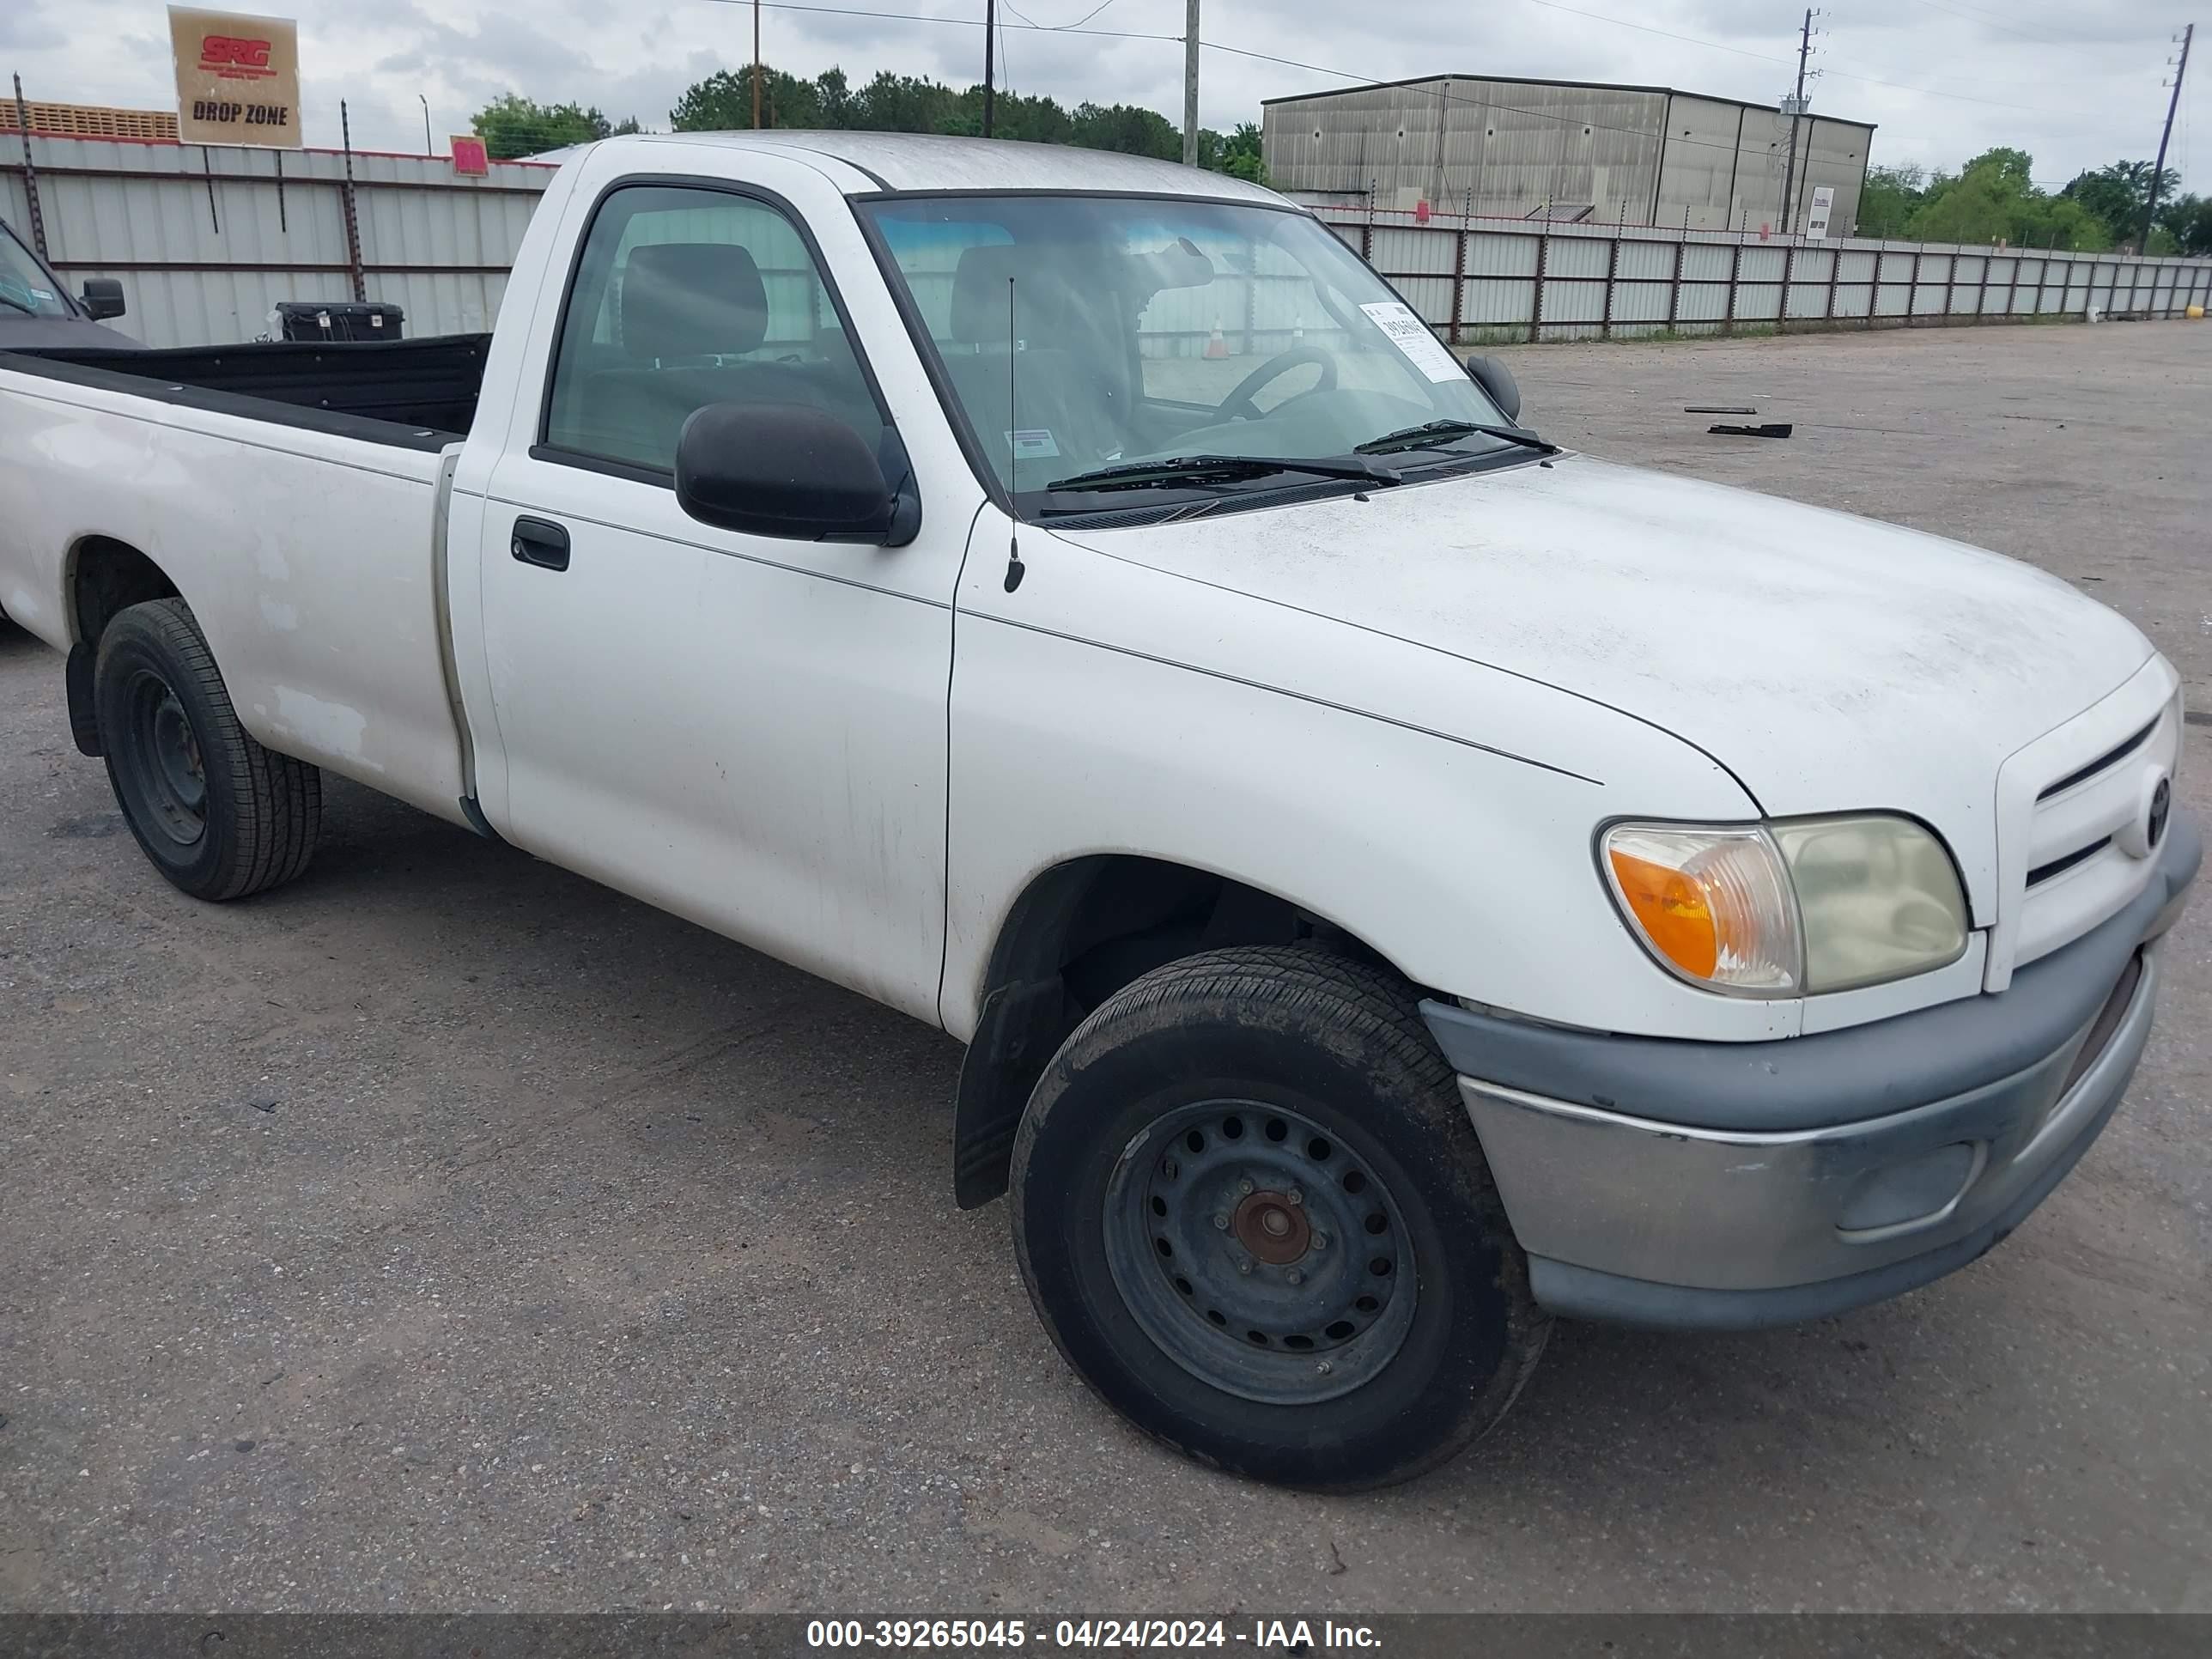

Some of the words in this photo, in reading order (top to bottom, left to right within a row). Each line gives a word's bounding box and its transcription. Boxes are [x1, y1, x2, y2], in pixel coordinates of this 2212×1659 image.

[201, 35, 271, 66] SRG
[192, 100, 242, 122] DROP
[246, 104, 289, 125] ZONE
